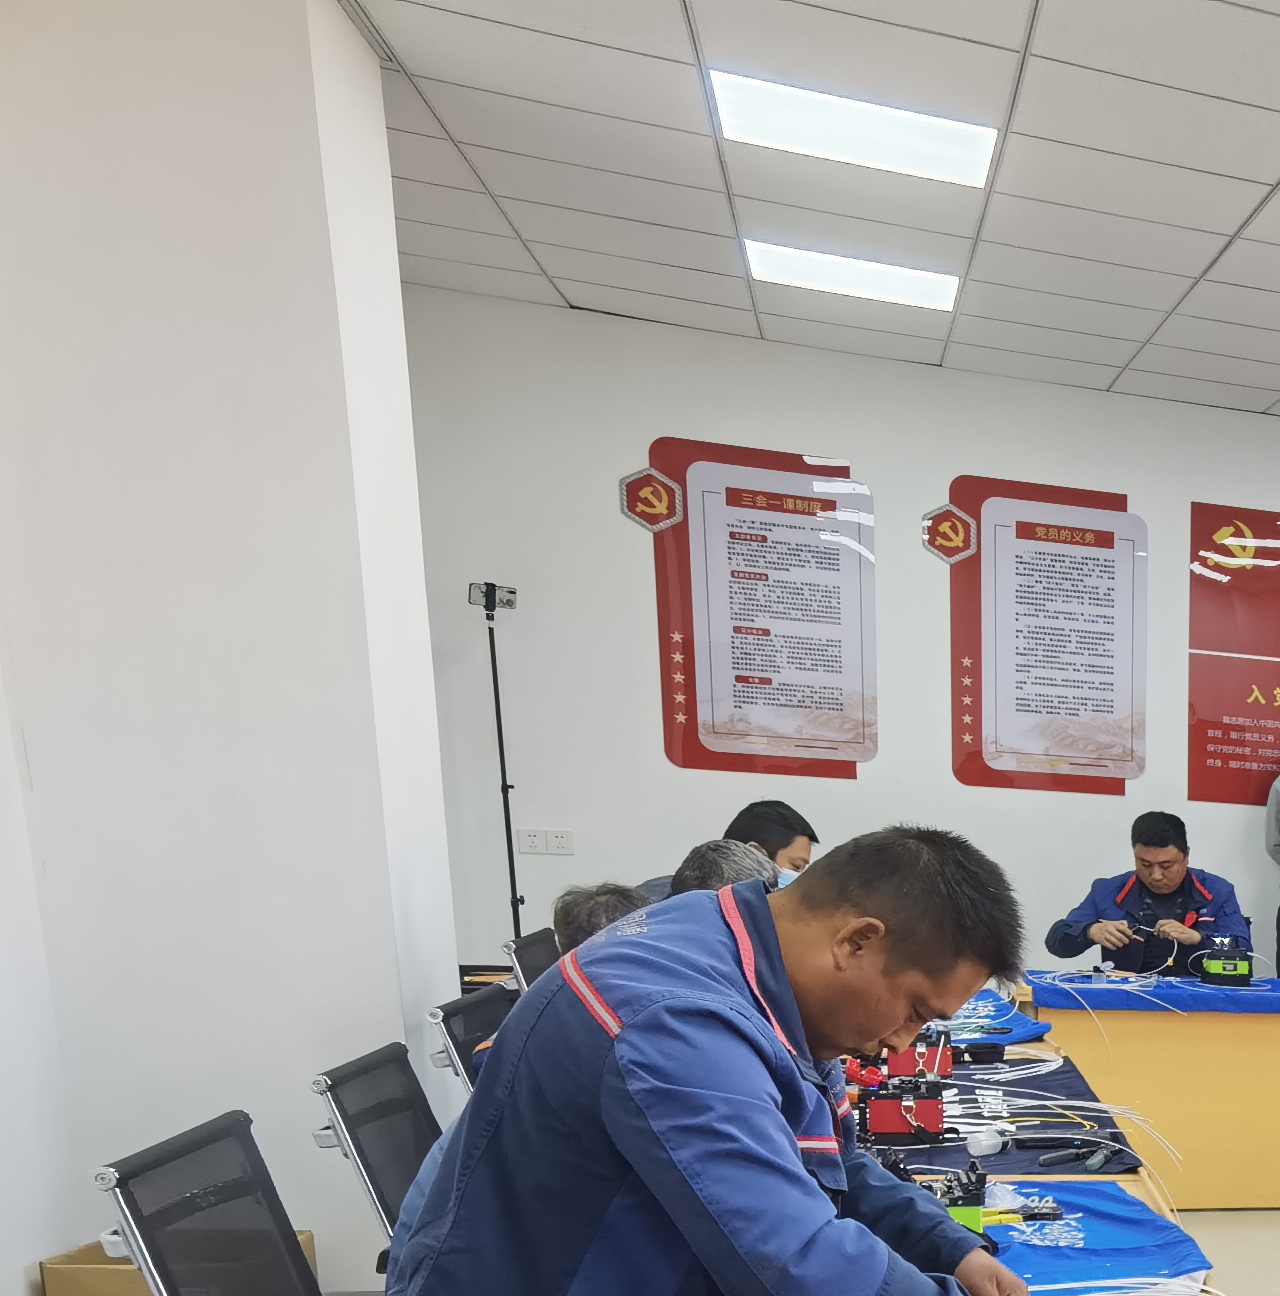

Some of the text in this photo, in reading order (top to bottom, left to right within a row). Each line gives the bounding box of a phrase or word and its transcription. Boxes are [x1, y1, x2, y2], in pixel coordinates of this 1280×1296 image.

[1035, 526, 1097, 545] 党员的义务
